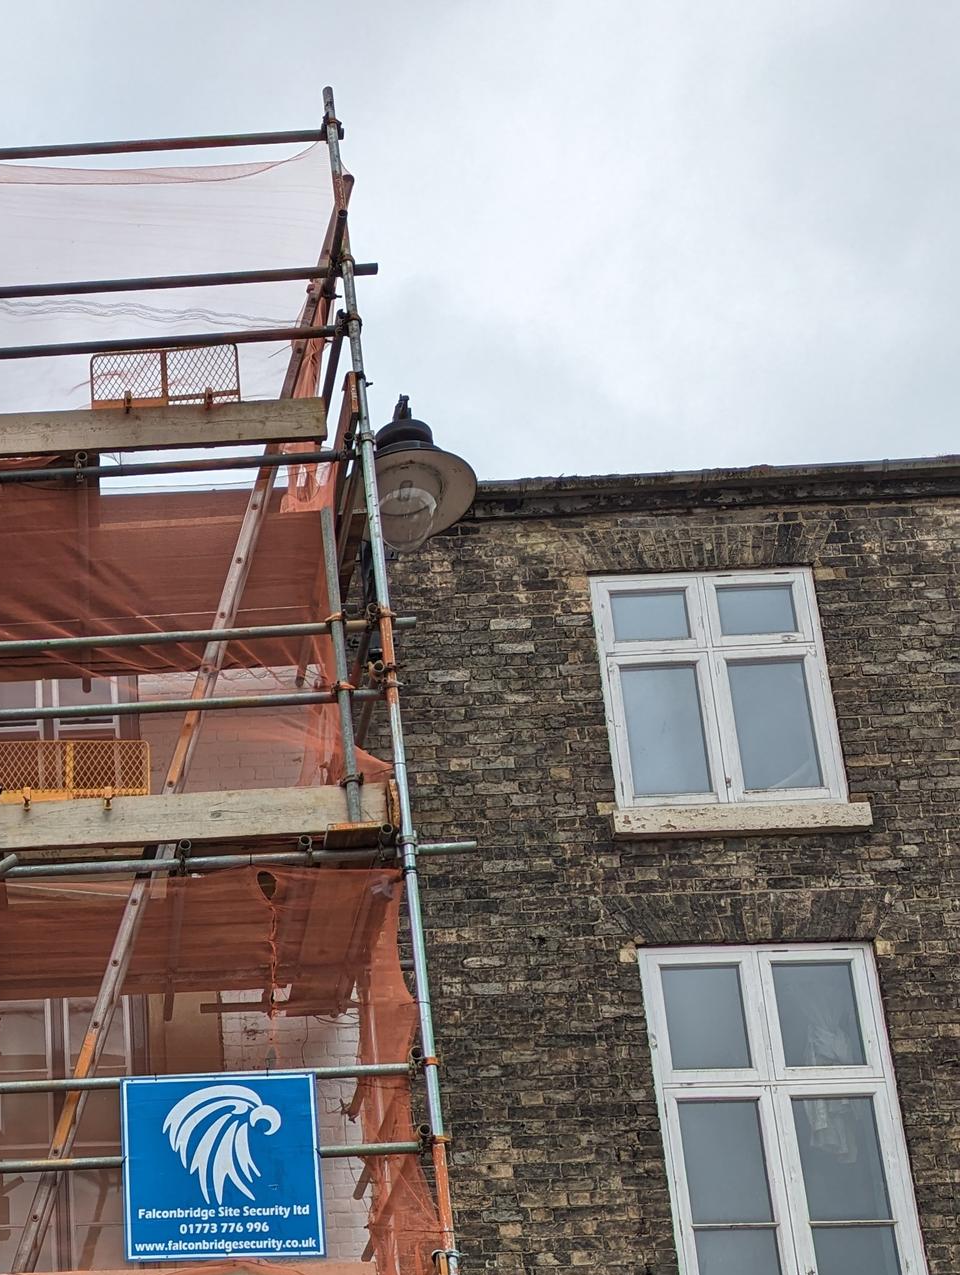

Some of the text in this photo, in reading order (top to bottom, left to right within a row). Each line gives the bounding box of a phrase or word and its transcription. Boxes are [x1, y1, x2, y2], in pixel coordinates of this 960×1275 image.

[138, 1204, 310, 1220] Falconbridge Site Security ltd
[180, 1222, 269, 1234] 01773 776 996
[135, 1237, 317, 1252] www.falconbridgesecurity.co.uk
